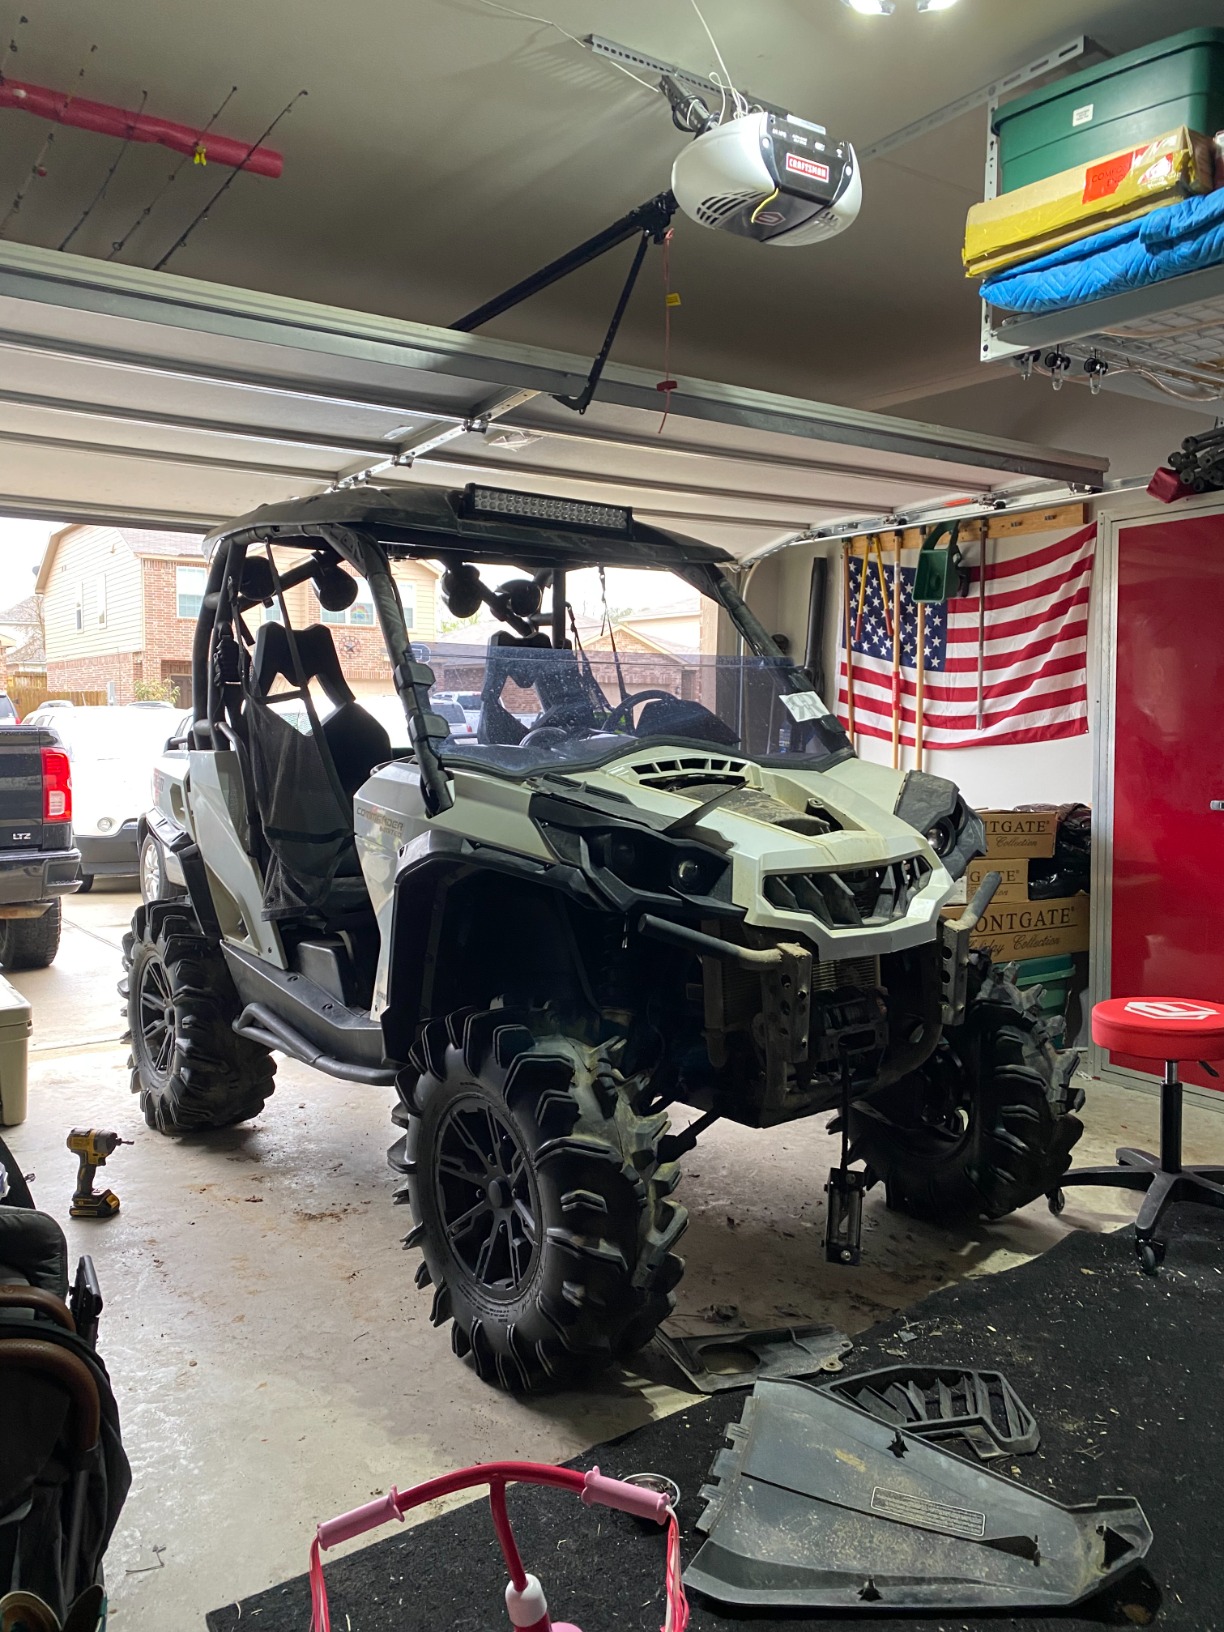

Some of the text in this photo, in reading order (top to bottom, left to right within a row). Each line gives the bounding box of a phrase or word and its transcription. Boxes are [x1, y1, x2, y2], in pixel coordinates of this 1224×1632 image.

[788, 158, 826, 178] CRAFTSMAN
[12, 832, 31, 841] LTZ
[995, 835, 1038, 848] Collection
[974, 907, 1071, 933] ONTGATE
[1013, 934, 1060, 951] Collection
